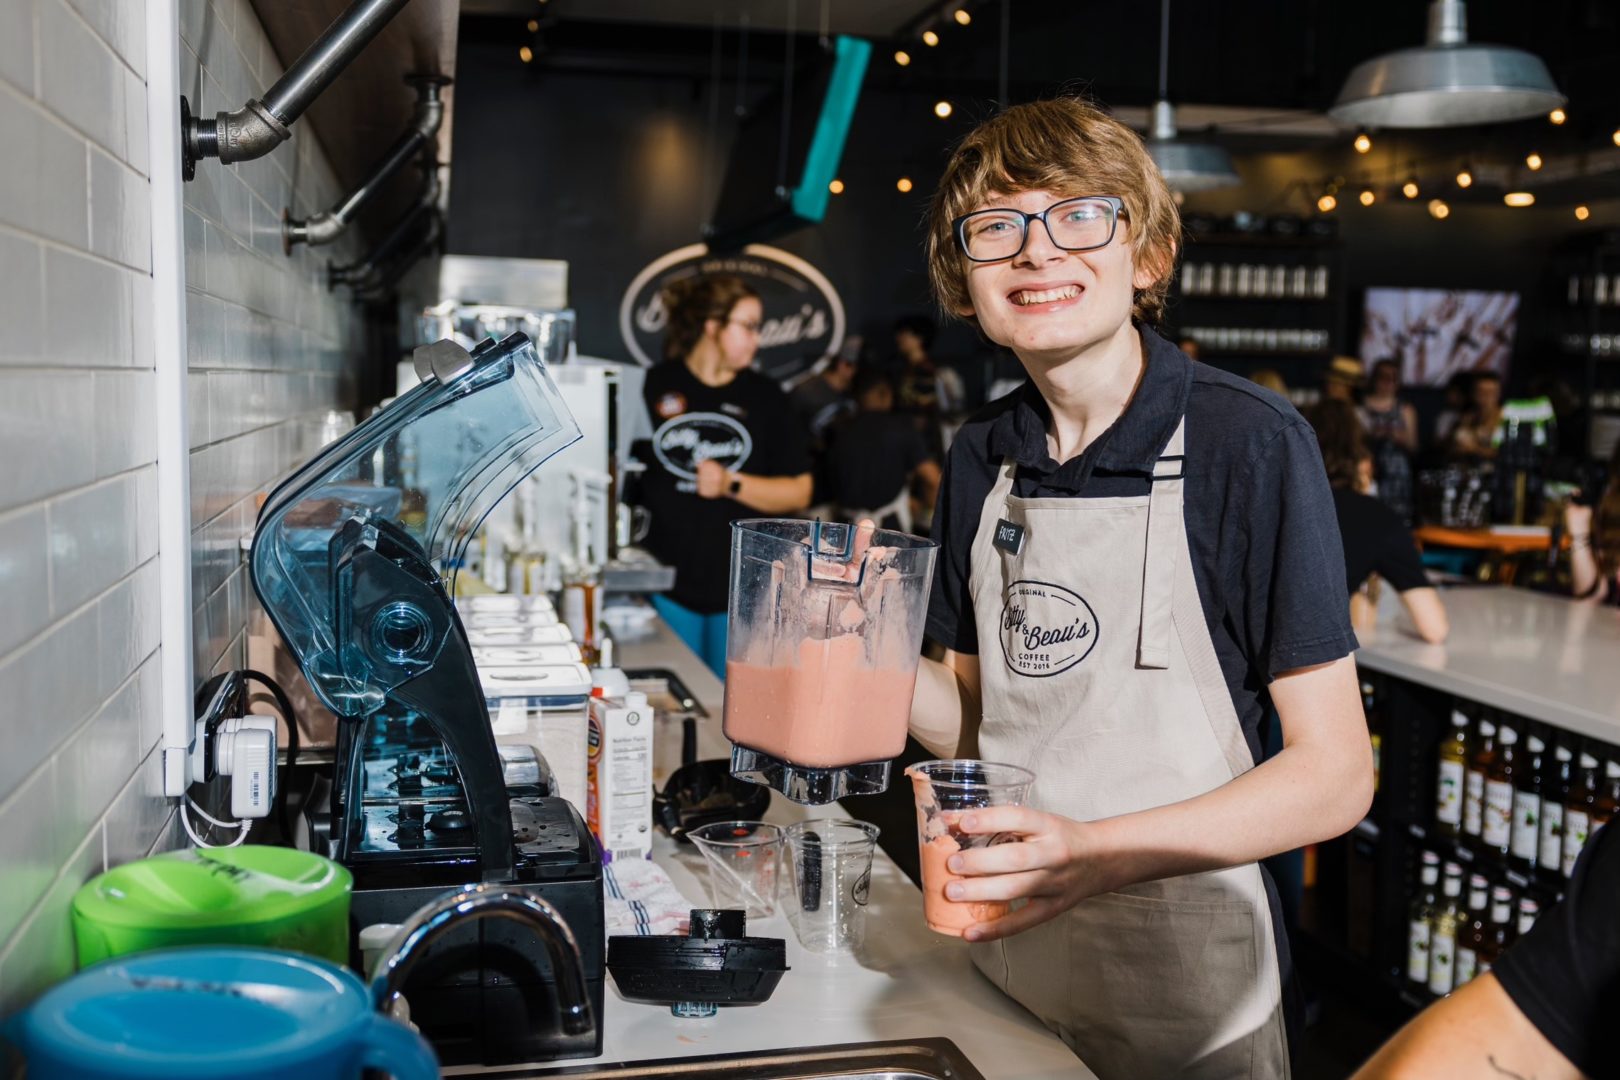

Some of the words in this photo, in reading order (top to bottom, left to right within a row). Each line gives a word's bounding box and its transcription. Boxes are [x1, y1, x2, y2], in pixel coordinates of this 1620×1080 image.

[999, 525, 1016, 542] FRITZ
[1022, 624, 1029, 636] &
[1024, 617, 1090, 650] Beau's
[1018, 653, 1050, 661] COFFEE
